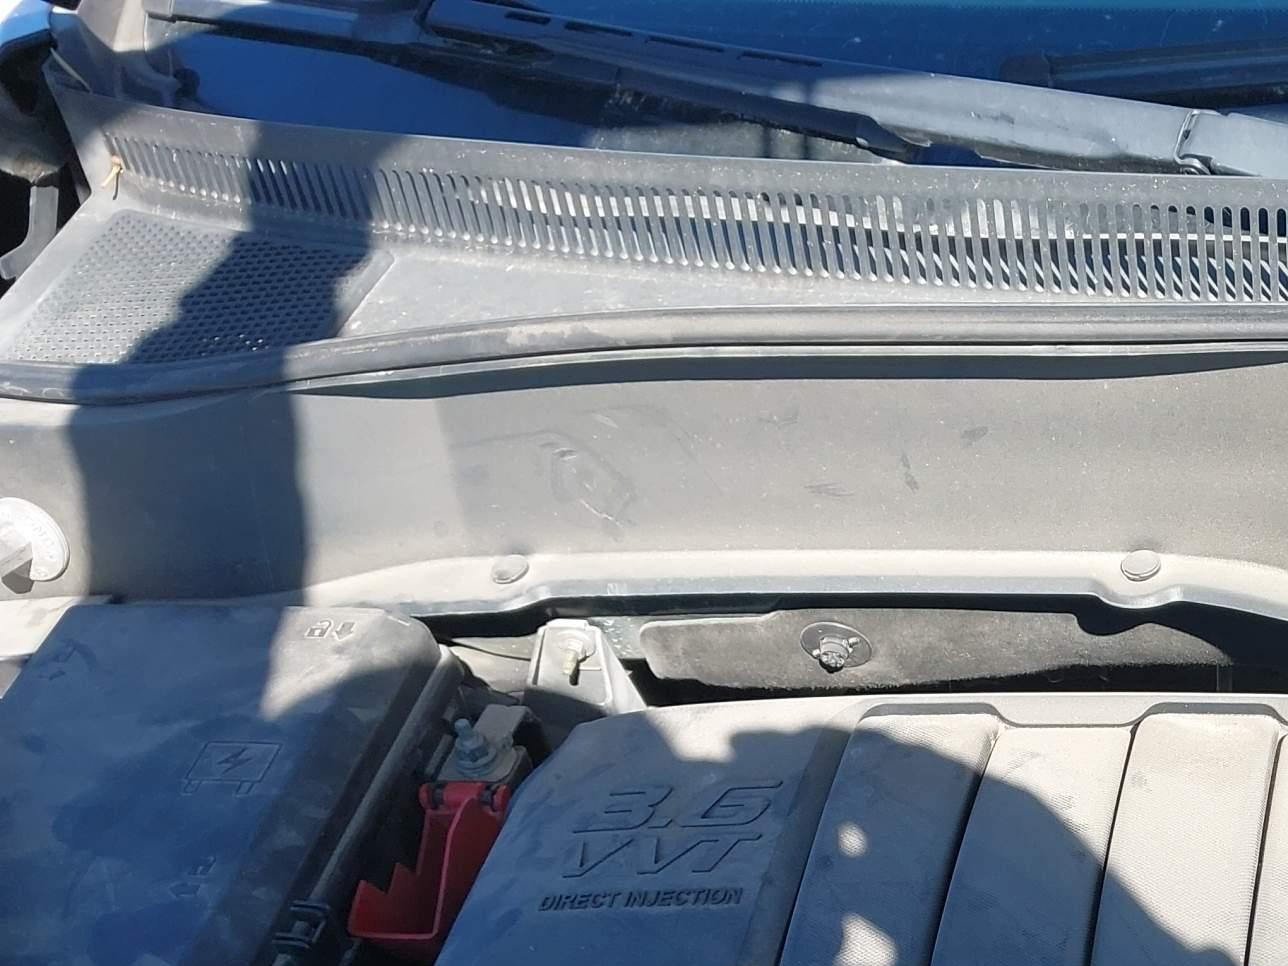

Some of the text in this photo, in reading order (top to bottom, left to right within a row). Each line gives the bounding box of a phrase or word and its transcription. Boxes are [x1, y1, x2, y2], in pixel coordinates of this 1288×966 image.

[572, 779, 784, 834] 3.6
[561, 832, 764, 879] VVT
[537, 887, 744, 912] DIRECT INJECTION
